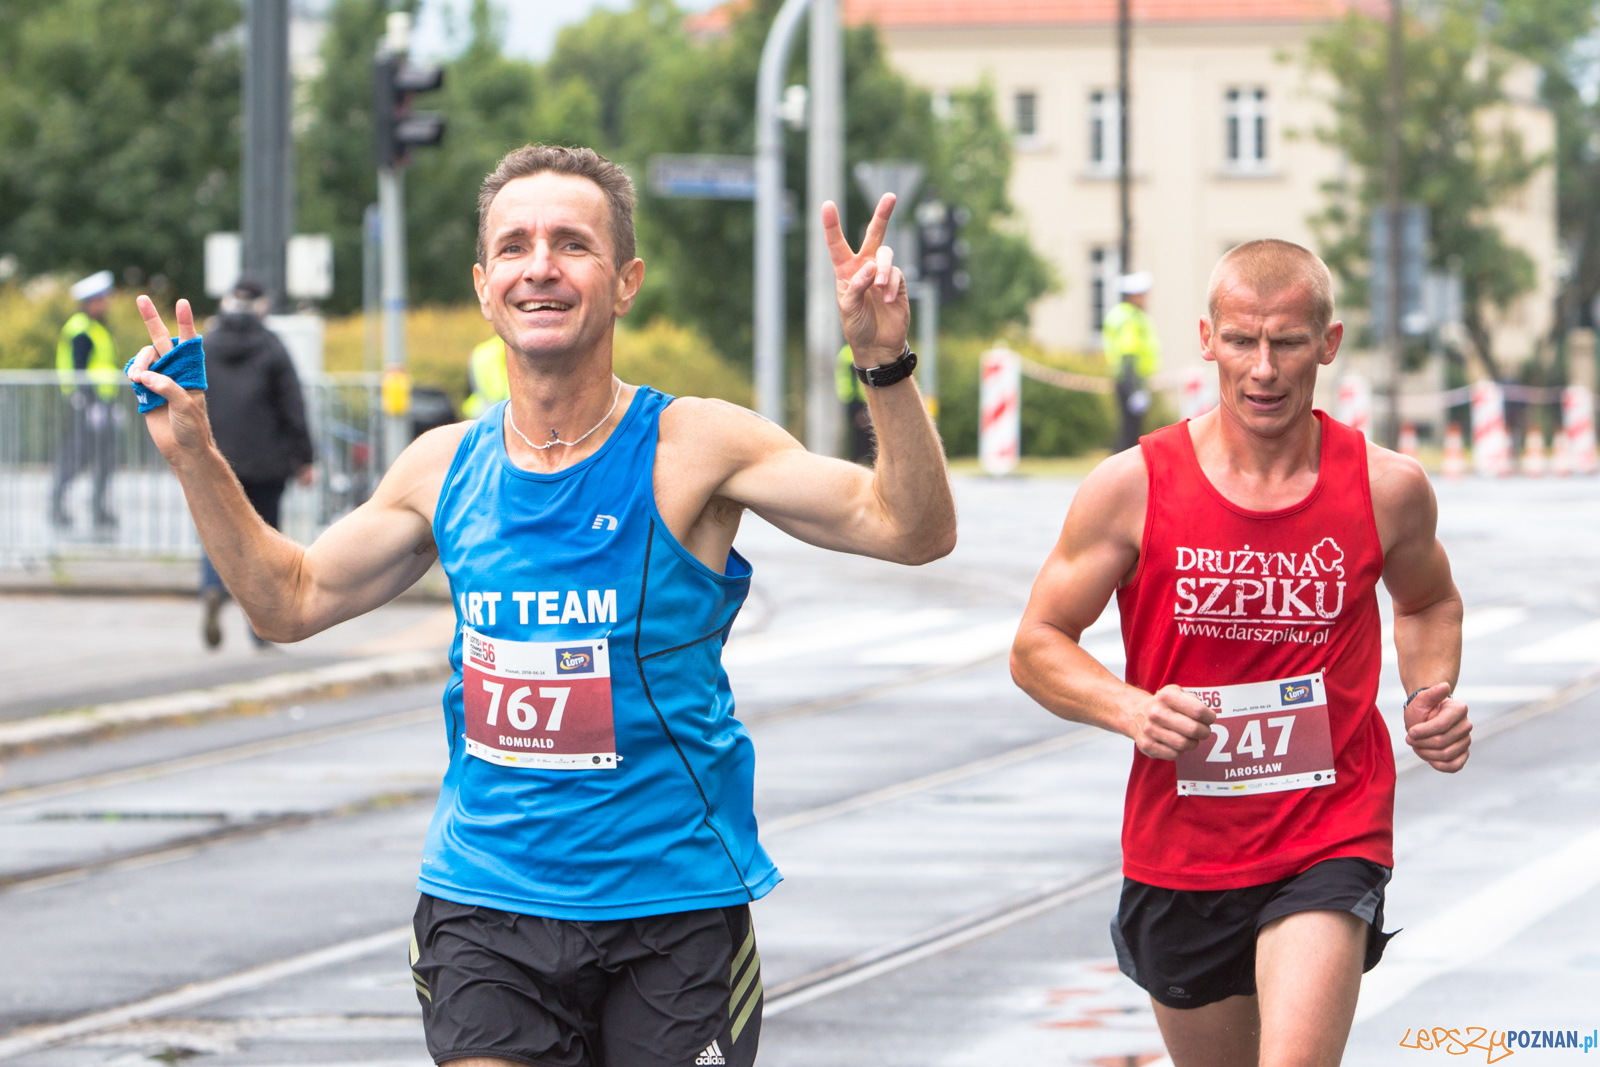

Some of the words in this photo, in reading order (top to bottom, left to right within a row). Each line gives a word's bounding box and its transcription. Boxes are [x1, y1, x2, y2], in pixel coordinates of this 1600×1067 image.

[1175, 544, 1319, 577] DRUŻYNA
[512, 589, 618, 625] TEAM
[1174, 577, 1347, 619] SZPIKU
[1177, 621, 1330, 647] www.darszpiku.pl
[565, 656, 585, 668] LOTTO
[483, 679, 571, 731] 767
[1288, 688, 1306, 700] LOTTO
[498, 735, 555, 749] ROMUALD
[1205, 715, 1296, 763] 247
[1224, 762, 1282, 780] JAROSŁAW
[695, 1055, 726, 1066] adidas
